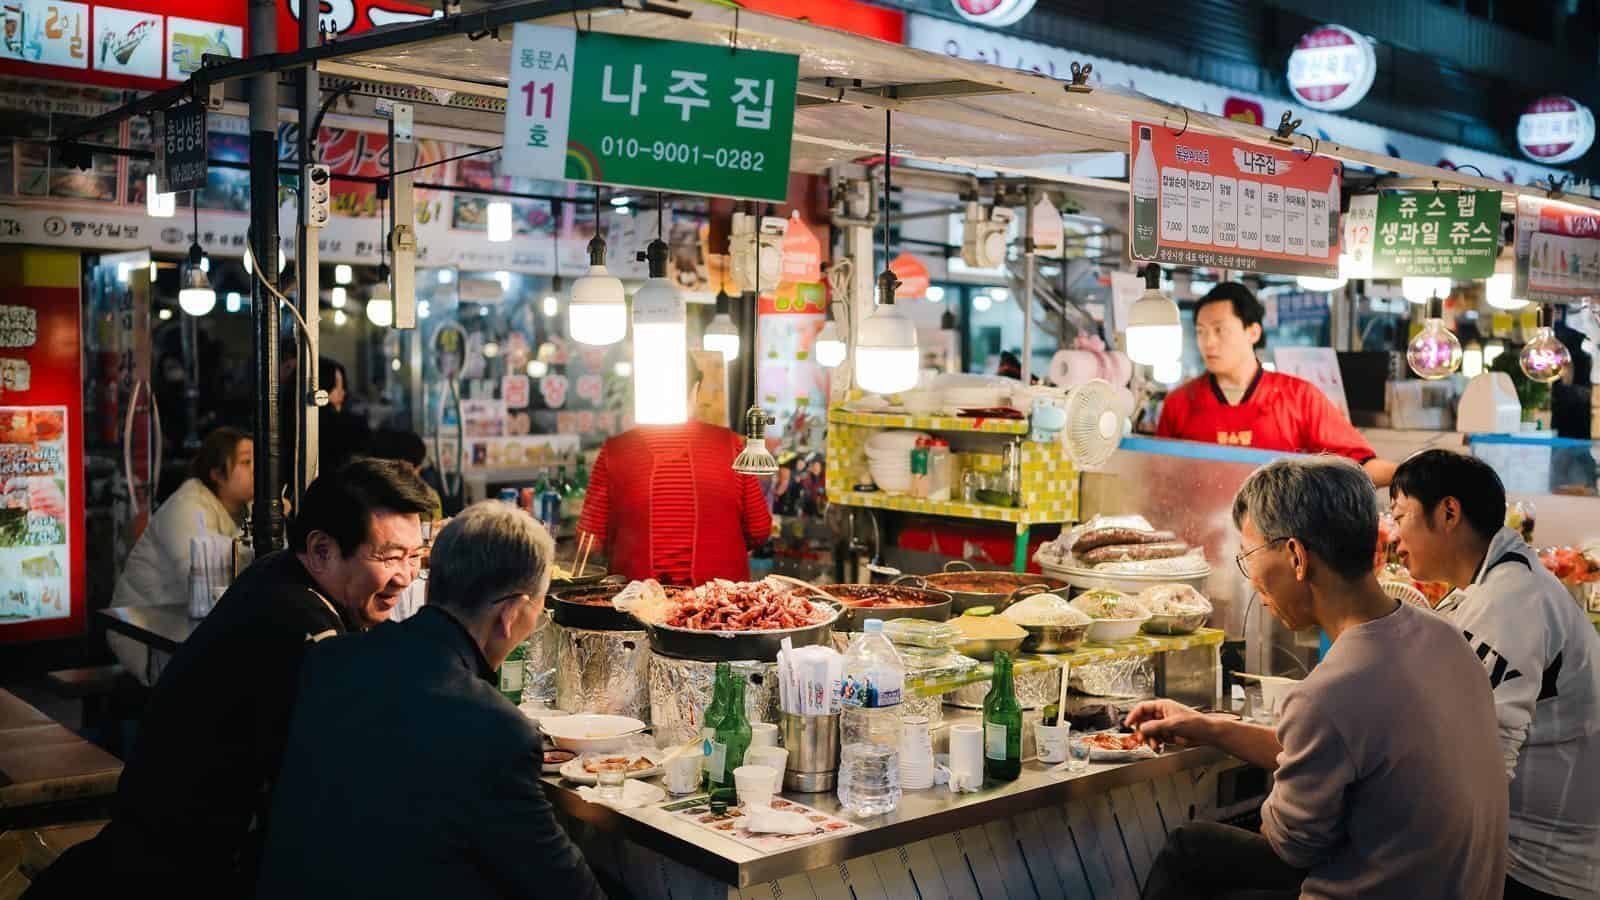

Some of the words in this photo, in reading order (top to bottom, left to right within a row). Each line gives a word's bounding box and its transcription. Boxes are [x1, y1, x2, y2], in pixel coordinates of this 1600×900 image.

[520, 48, 569, 72] 동문A
[520, 80, 554, 119] 11
[601, 63, 775, 130] 나주집
[527, 124, 549, 148] 호
[601, 135, 765, 172] 010-9001-0282
[1243, 151, 1277, 175] 나주집
[1398, 195, 1476, 218] 쥬스랩
[1167, 221, 1183, 232] 7,000
[1351, 224, 1369, 244] 12
[1380, 221, 1440, 246] 생과일
[1449, 221, 1493, 246] 쥬스
